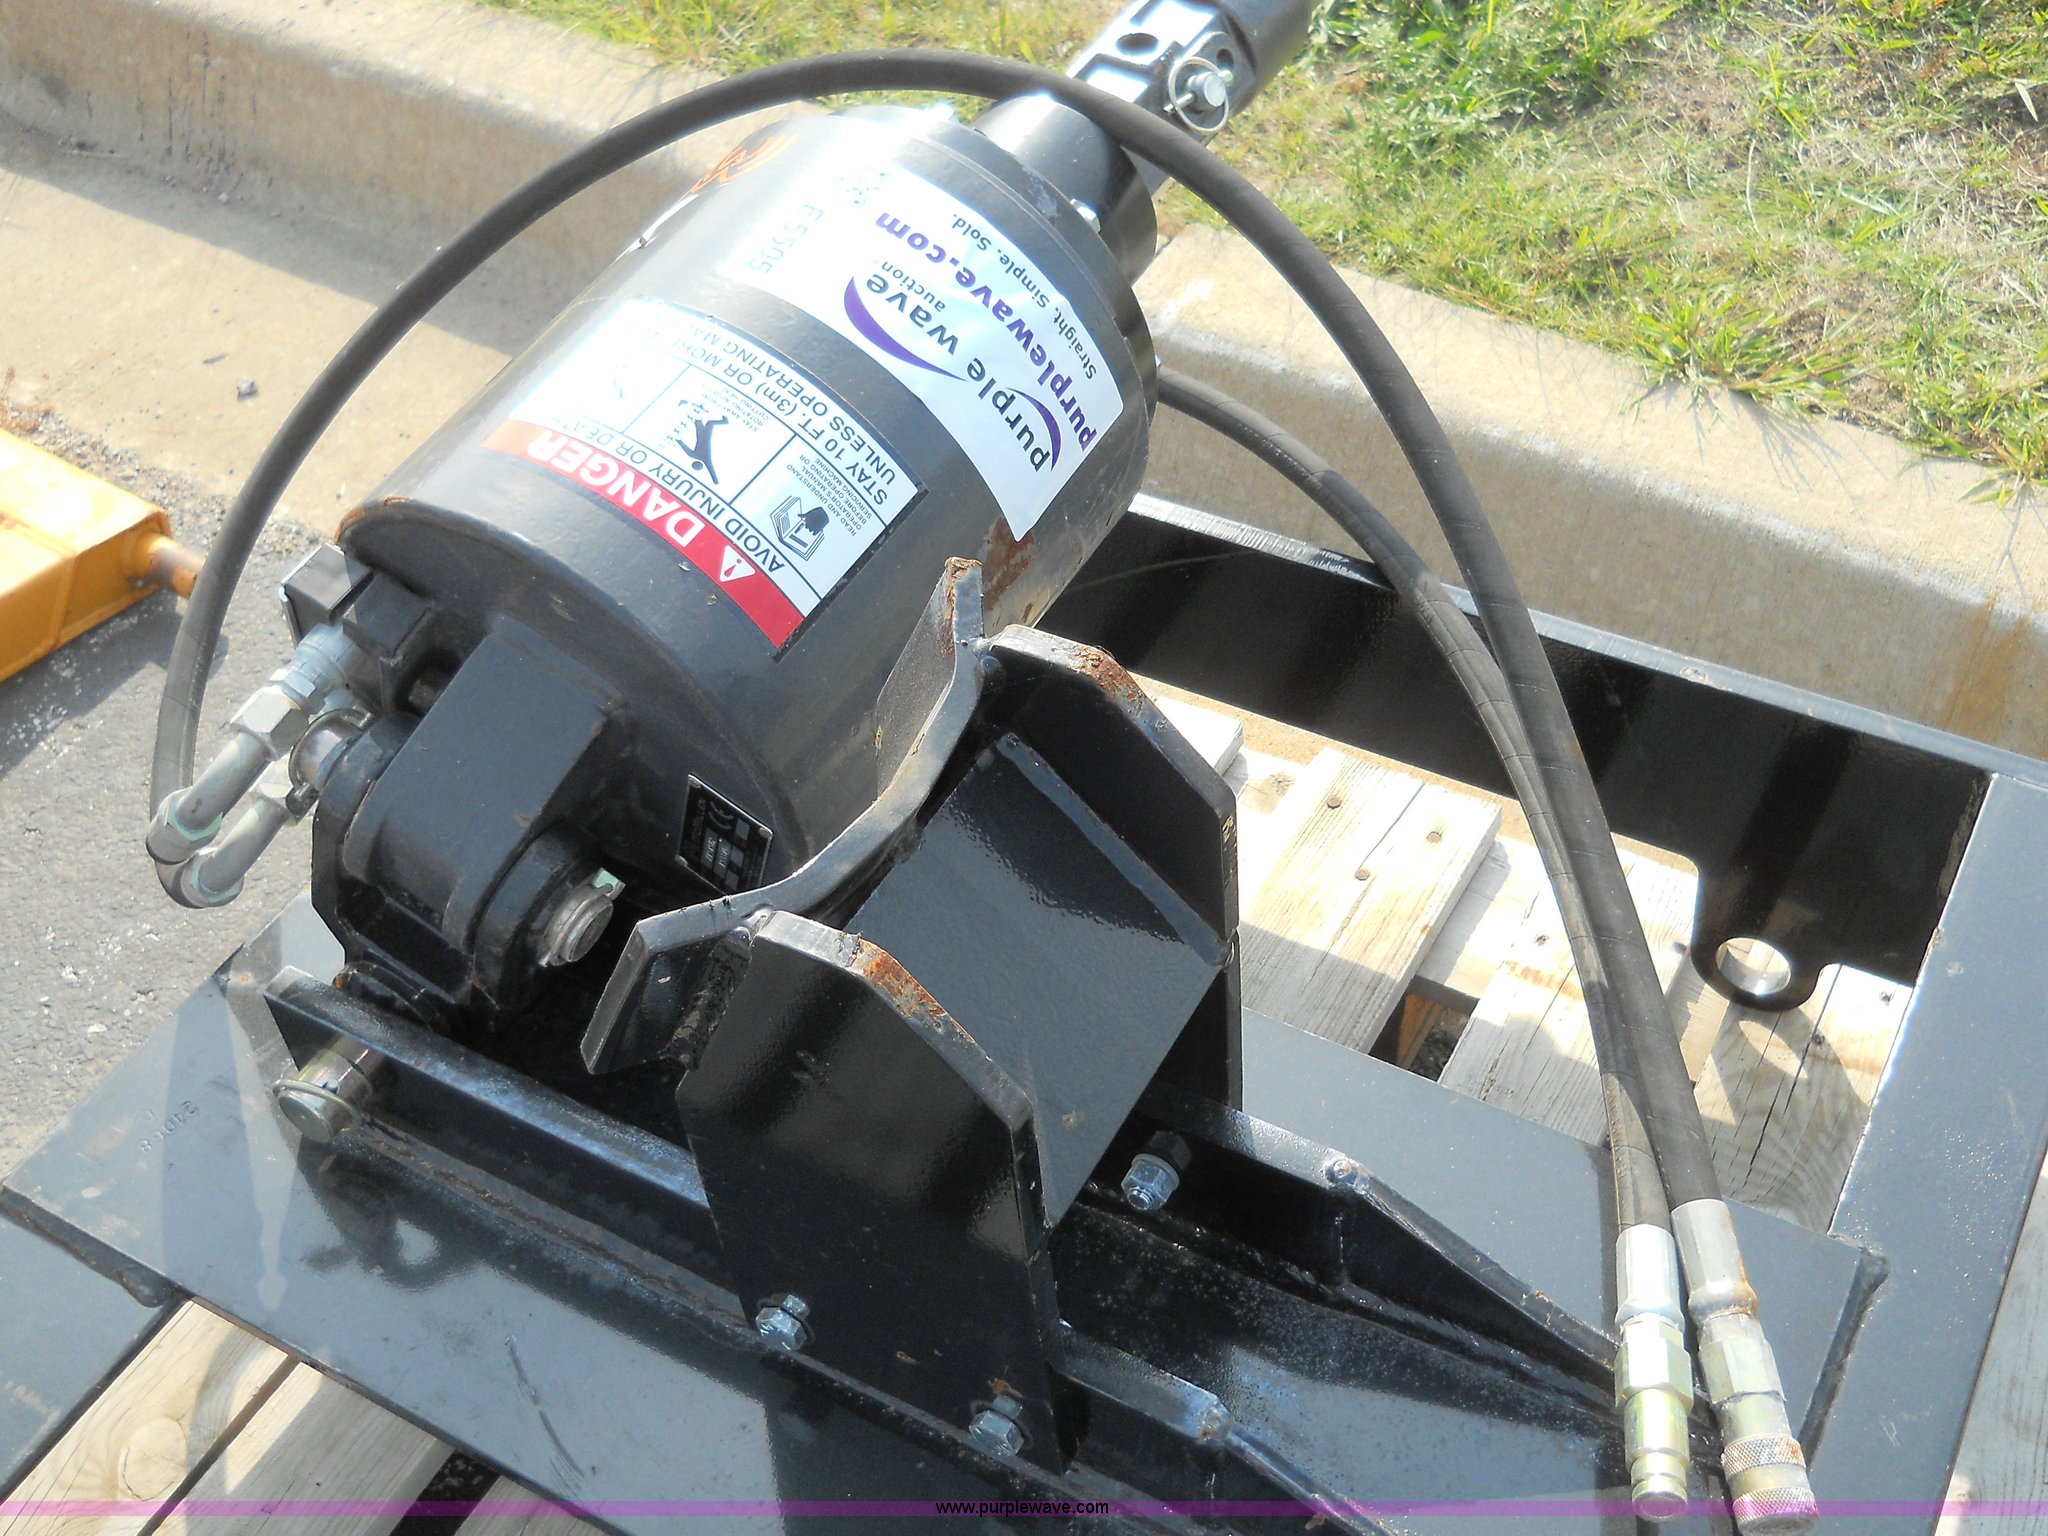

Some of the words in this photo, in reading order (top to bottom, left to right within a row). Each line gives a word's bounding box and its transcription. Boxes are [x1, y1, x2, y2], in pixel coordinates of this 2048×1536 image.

[952, 213, 992, 251] Sold.
[881, 261, 946, 312] auction
[997, 249, 1050, 309] Simple.
[866, 273, 959, 356] wave
[875, 212, 1097, 452] purplewave.com
[1053, 307, 1097, 380] Straight.
[722, 341, 828, 417] OPERATING
[723, 363, 753, 386] OR
[755, 382, 797, 416] (3m)
[967, 357, 1051, 472] purple
[797, 412, 825, 440] FT.
[615, 441, 648, 465] OR
[799, 454, 811, 465] OR
[824, 438, 845, 460] 10
[829, 416, 896, 486] UNLESS
[526, 429, 706, 548] DANGER
[649, 463, 725, 521] INJURY
[786, 463, 828, 505] UNDERSTAND
[802, 466, 827, 491] MANUAL
[810, 460, 845, 498] OPERATING
[814, 457, 843, 488] MACHINE
[846, 461, 888, 505] STAY
[826, 490, 862, 530] OPERATOR'S
[827, 503, 841, 518] AND
[843, 498, 867, 525] BEFORE
[845, 485, 873, 519] SERVICING
[725, 518, 785, 573] AVOID
[840, 517, 857, 536] READ
